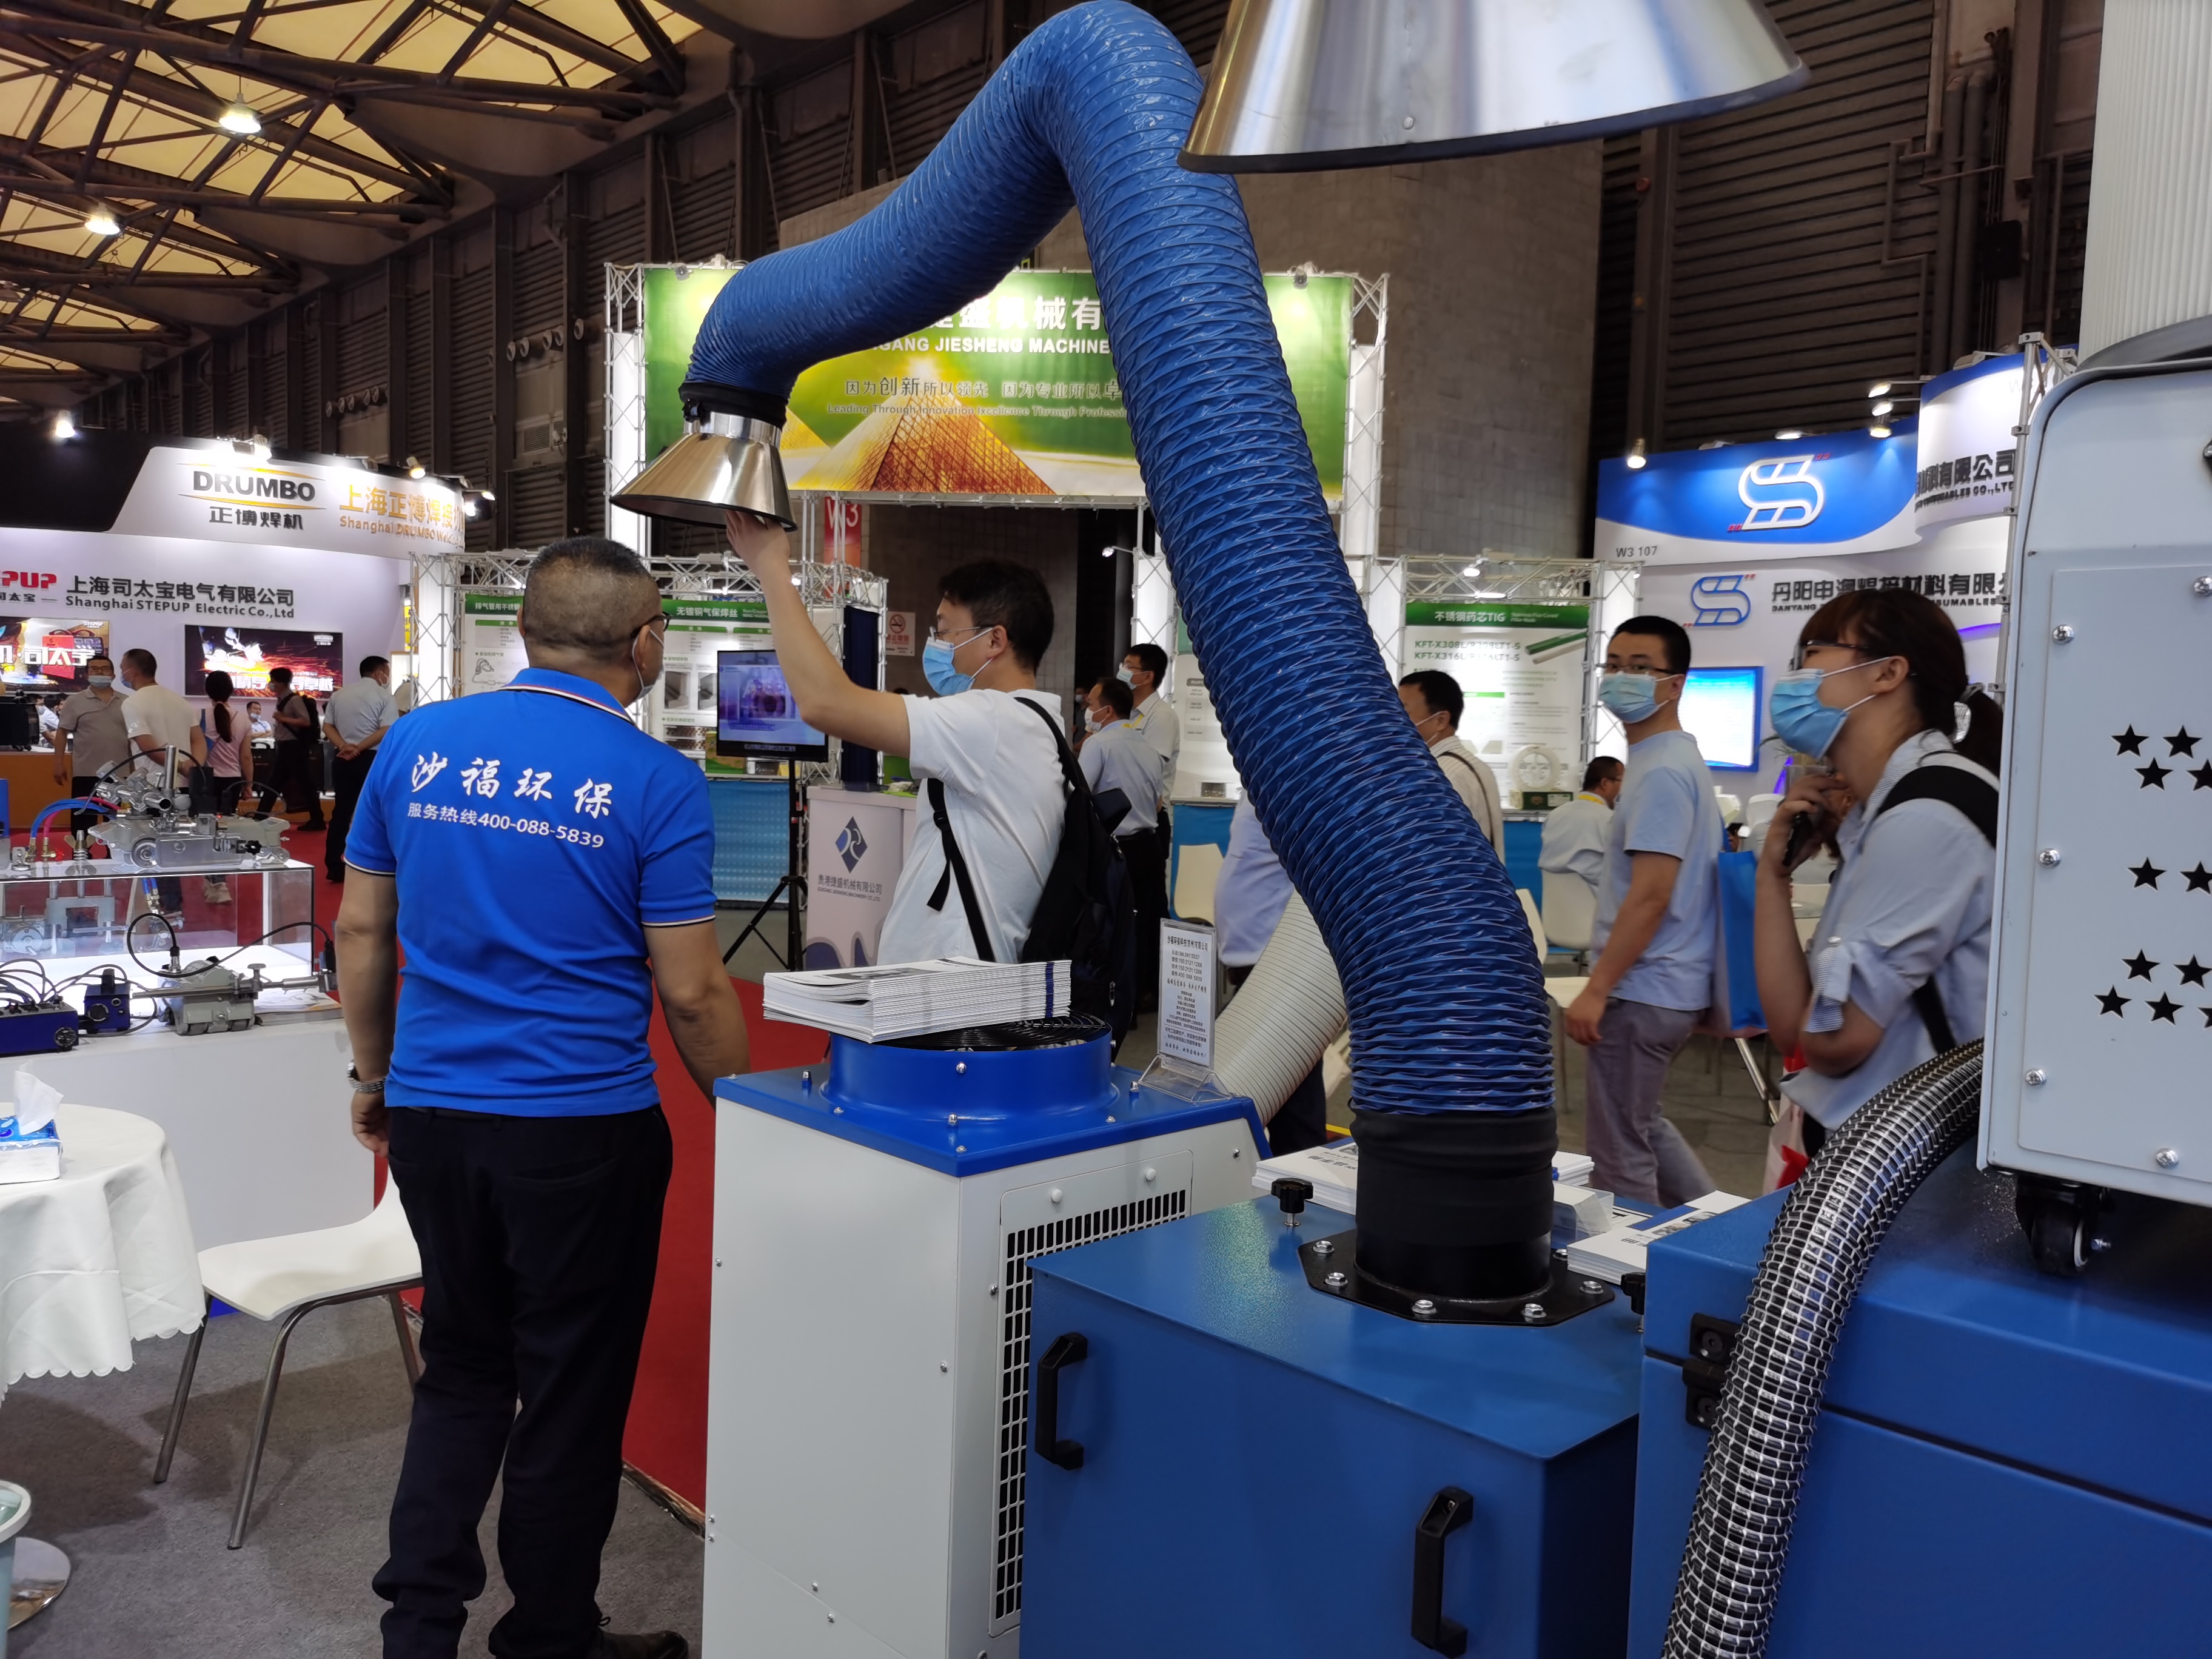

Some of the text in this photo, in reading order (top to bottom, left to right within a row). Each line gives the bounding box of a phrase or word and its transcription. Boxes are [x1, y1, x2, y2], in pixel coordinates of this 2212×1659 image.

[931, 296, 1101, 330] 盛机械有
[934, 337, 1024, 354] JIESHENG
[845, 377, 1121, 400] 因为创新所以领先 因为专业所以卓
[828, 404, 869, 416] Leading
[873, 404, 916, 416] Through
[919, 405, 974, 416] Innovation
[1033, 406, 1077, 419] Through
[193, 471, 315, 502] DRUMBO
[209, 506, 304, 530] 正博焊机
[340, 515, 394, 534] Shanghai
[1615, 546, 1658, 558] W3 107
[0, 571, 57, 589] PUP
[67, 575, 294, 606] 上海司太宝电气有限公司
[66, 595, 295, 618] Shanghai STEPUP Electric Co.,Ltd
[1435, 611, 1506, 622] 不锈钢药芯TIG
[1772, 603, 1817, 612] DANYANG
[412, 751, 613, 819] 沙福环保
[407, 802, 604, 848] 服务热线400-088-5839
